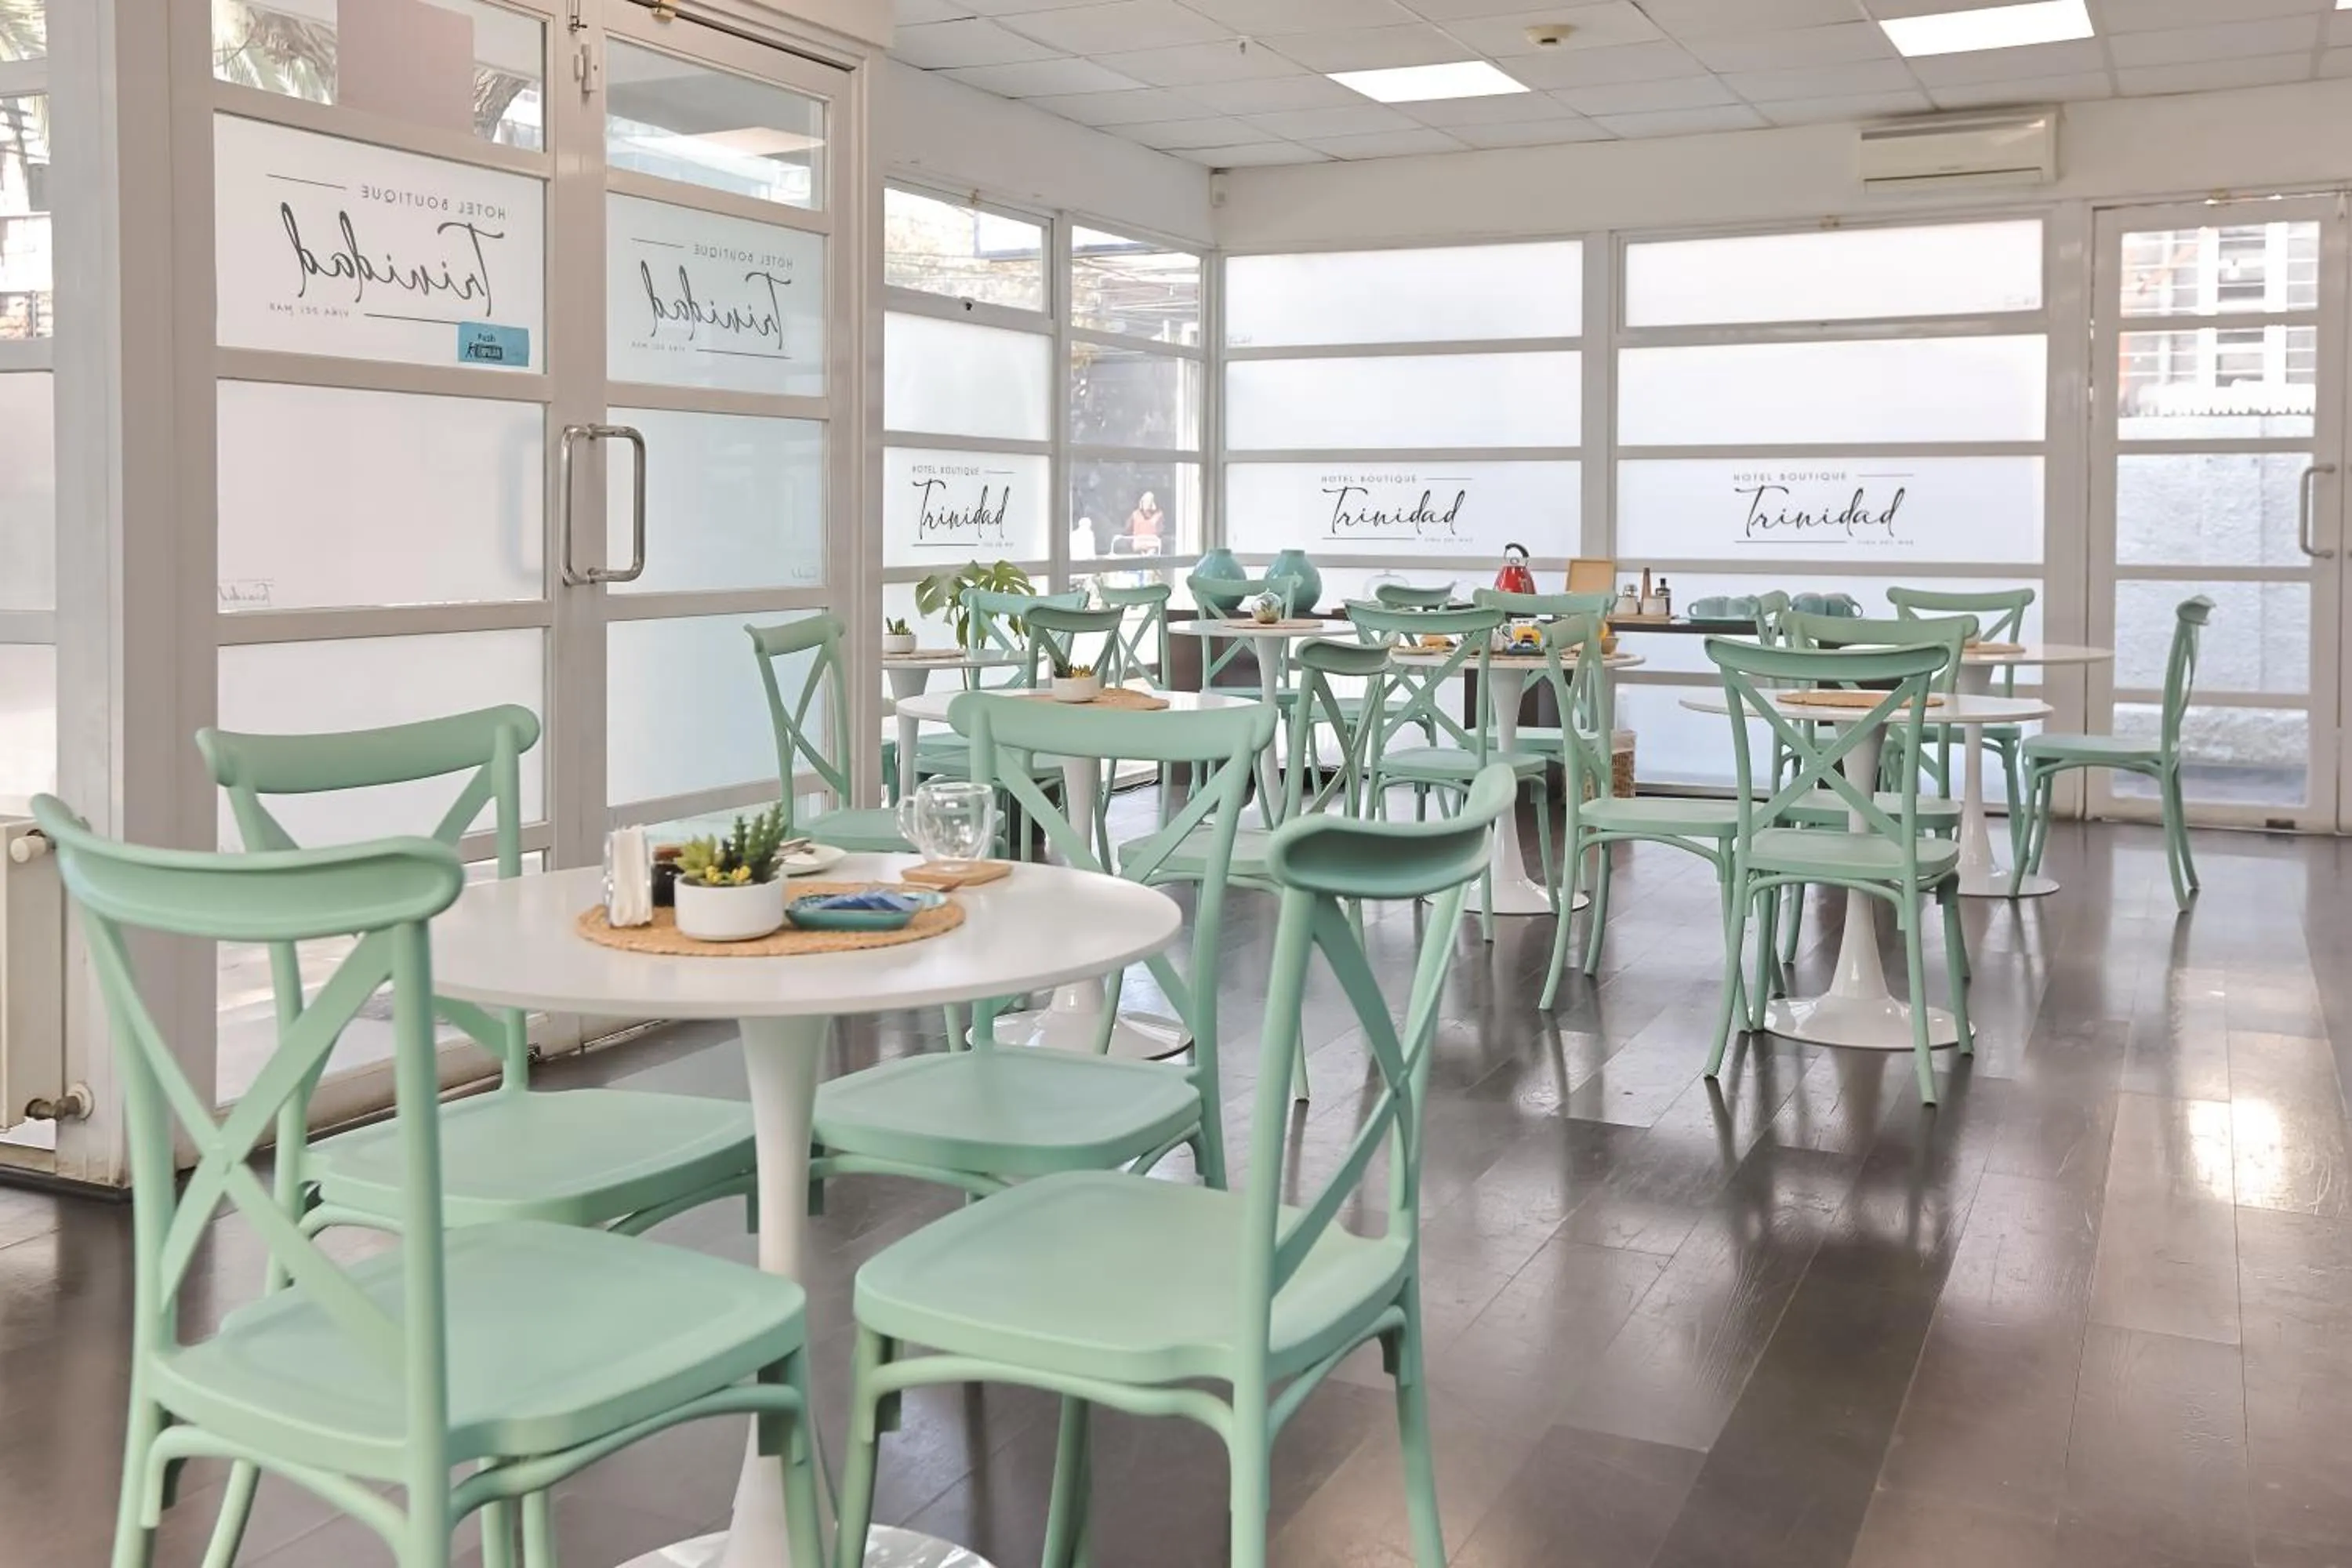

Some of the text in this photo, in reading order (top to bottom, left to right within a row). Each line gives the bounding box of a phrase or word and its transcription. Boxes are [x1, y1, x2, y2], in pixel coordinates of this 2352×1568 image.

[1321, 474, 1418, 485] HOTEL BOUTIQUE
[1733, 472, 1847, 481] HOTEL BOUTIQUE
[912, 478, 1010, 540] Trinidad
[1322, 486, 1466, 535] Trinidad
[1734, 485, 1905, 538] Trinidad
